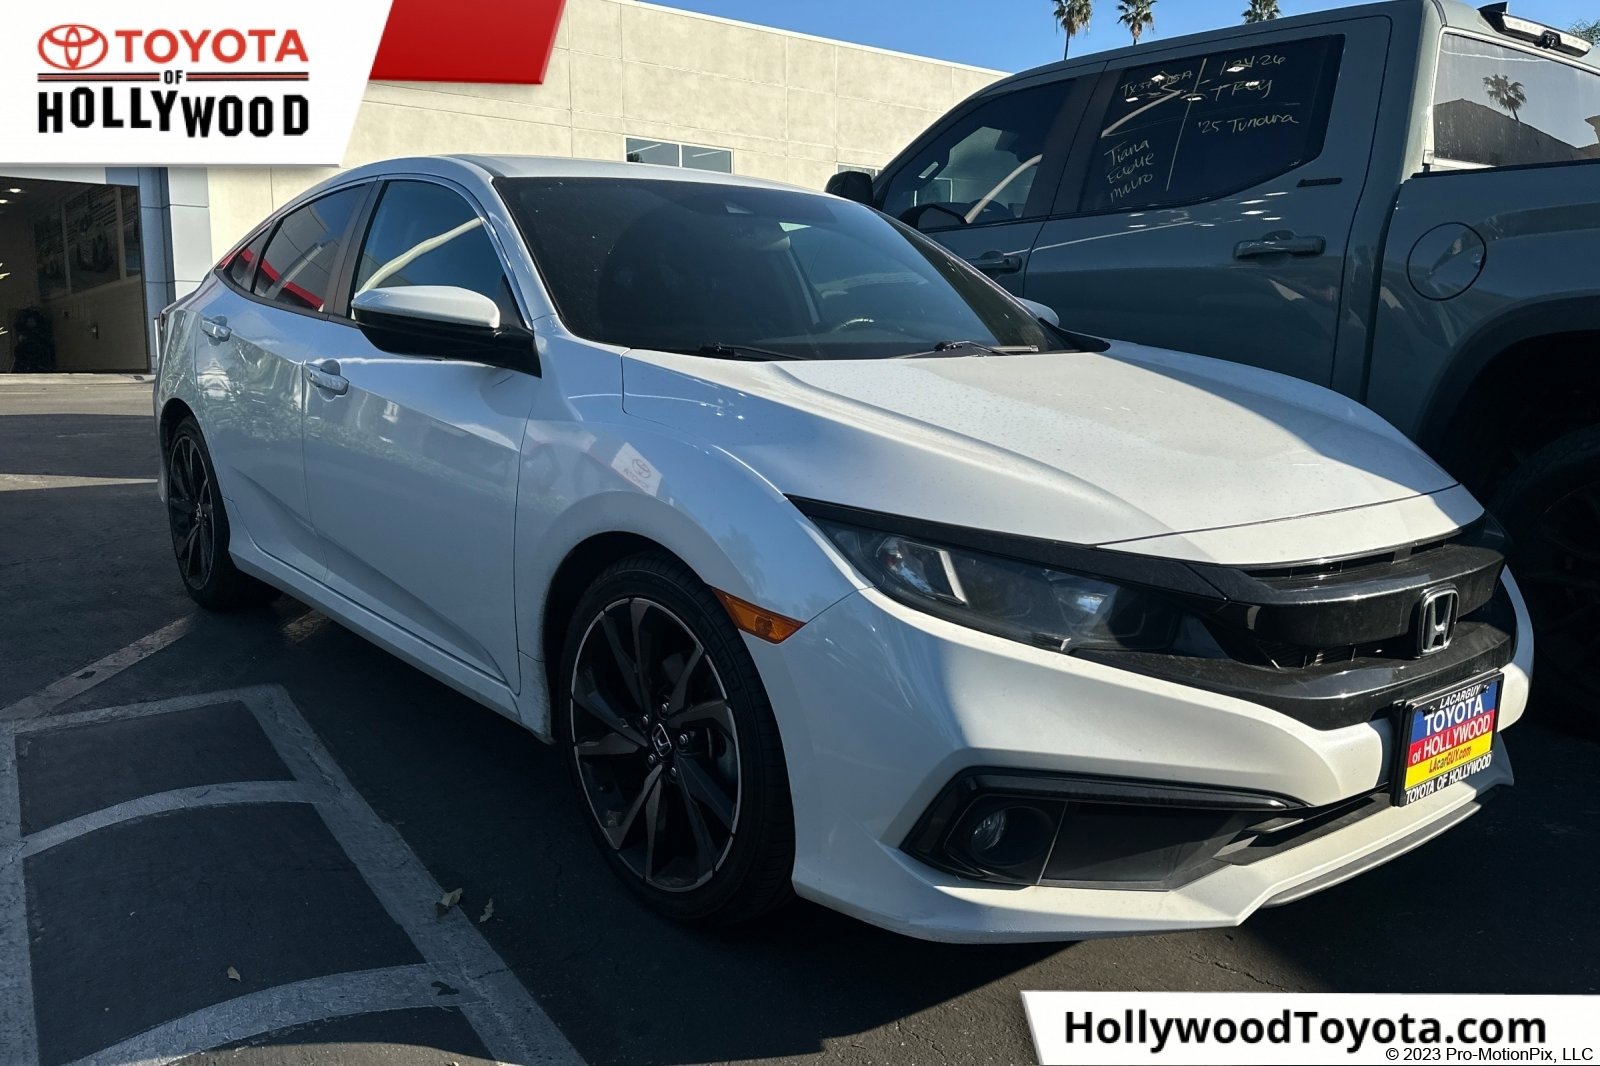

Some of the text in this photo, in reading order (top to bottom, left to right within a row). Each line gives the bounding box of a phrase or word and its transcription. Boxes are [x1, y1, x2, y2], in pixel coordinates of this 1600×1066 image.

[1424, 695, 1484, 736] TOYOTA
[1439, 684, 1481, 710] LACARGUY
[1412, 715, 1491, 764] of HOLLYWOOD
[1406, 754, 1492, 805] TOYOTA OF HOLLYWOOD
